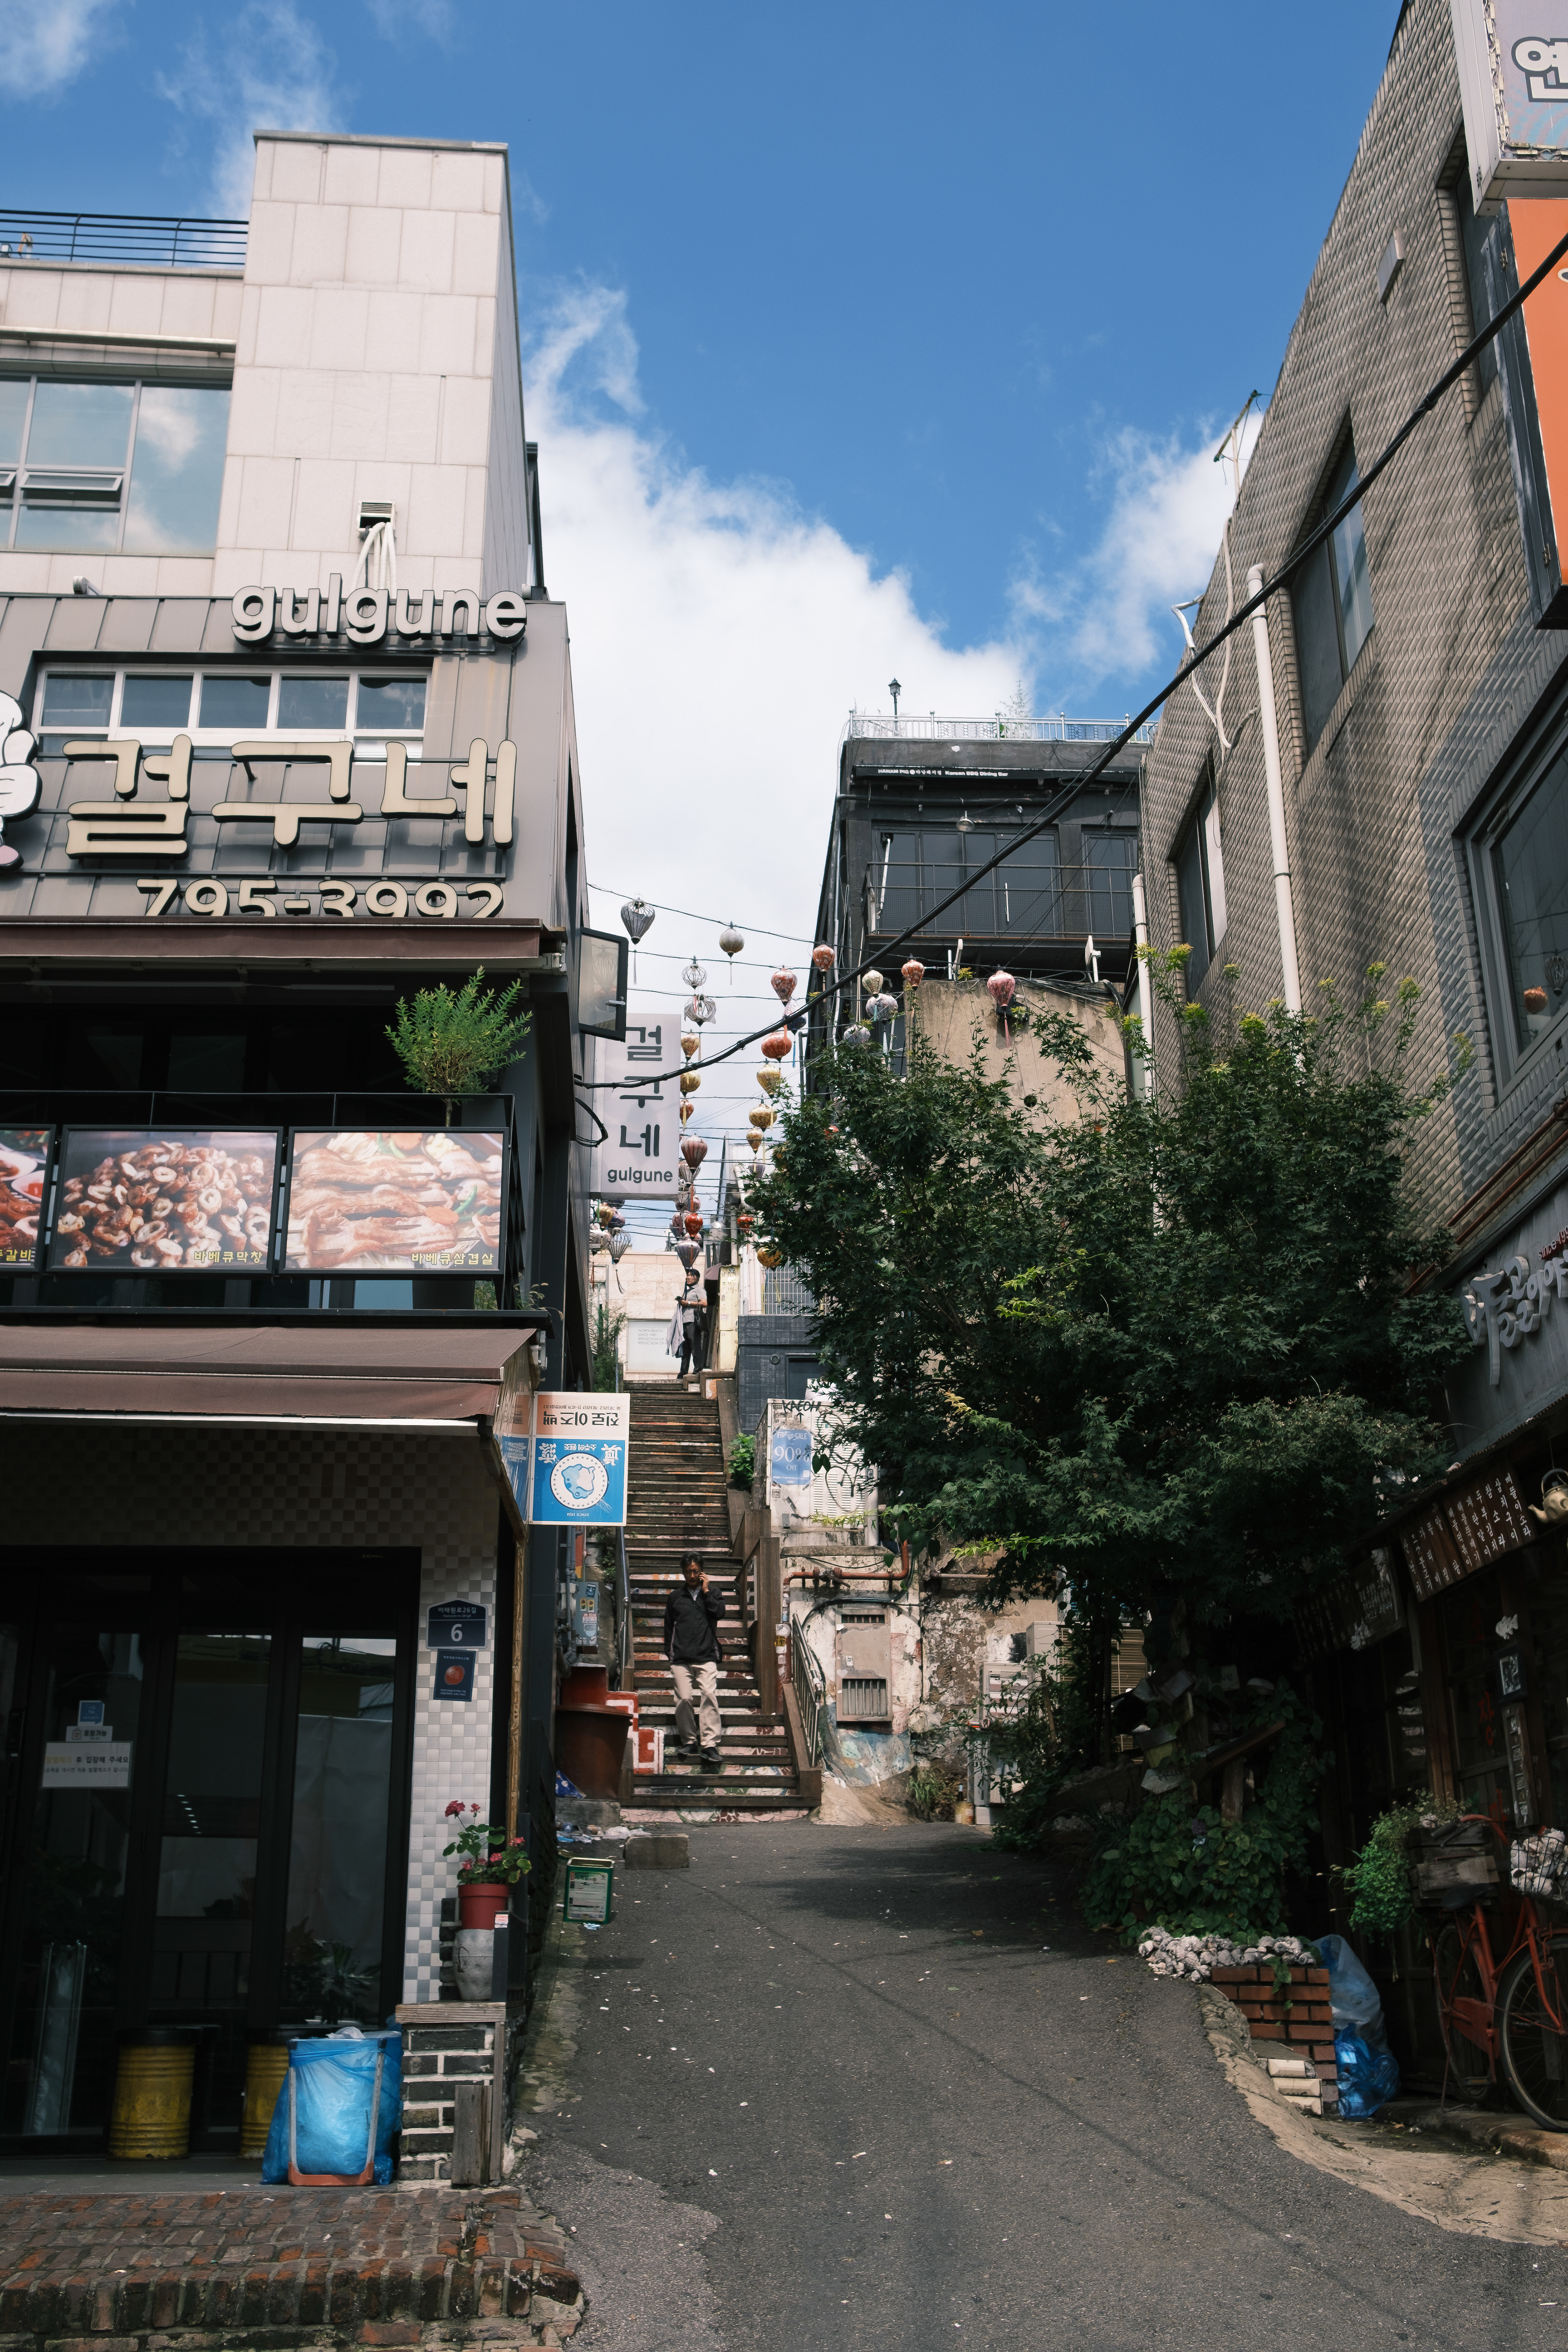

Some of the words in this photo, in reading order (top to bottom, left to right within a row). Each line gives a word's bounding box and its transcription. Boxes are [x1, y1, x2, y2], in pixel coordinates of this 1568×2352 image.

[231, 573, 528, 648] gulgune
[62, 734, 517, 859] 걸구네
[136, 878, 504, 918] 795-3992
[619, 1025, 664, 1157] 걸구네
[608, 1167, 673, 1183] gulgune
[194, 1250, 263, 1263] 바베큐막창
[411, 1252, 494, 1265] 바베큐삼겹살
[1539, 1239, 1557, 1260] since
[774, 1446, 810, 1462] 90%
[1476, 1490, 1498, 1551] 두부김치
[451, 1624, 463, 1642] 6
